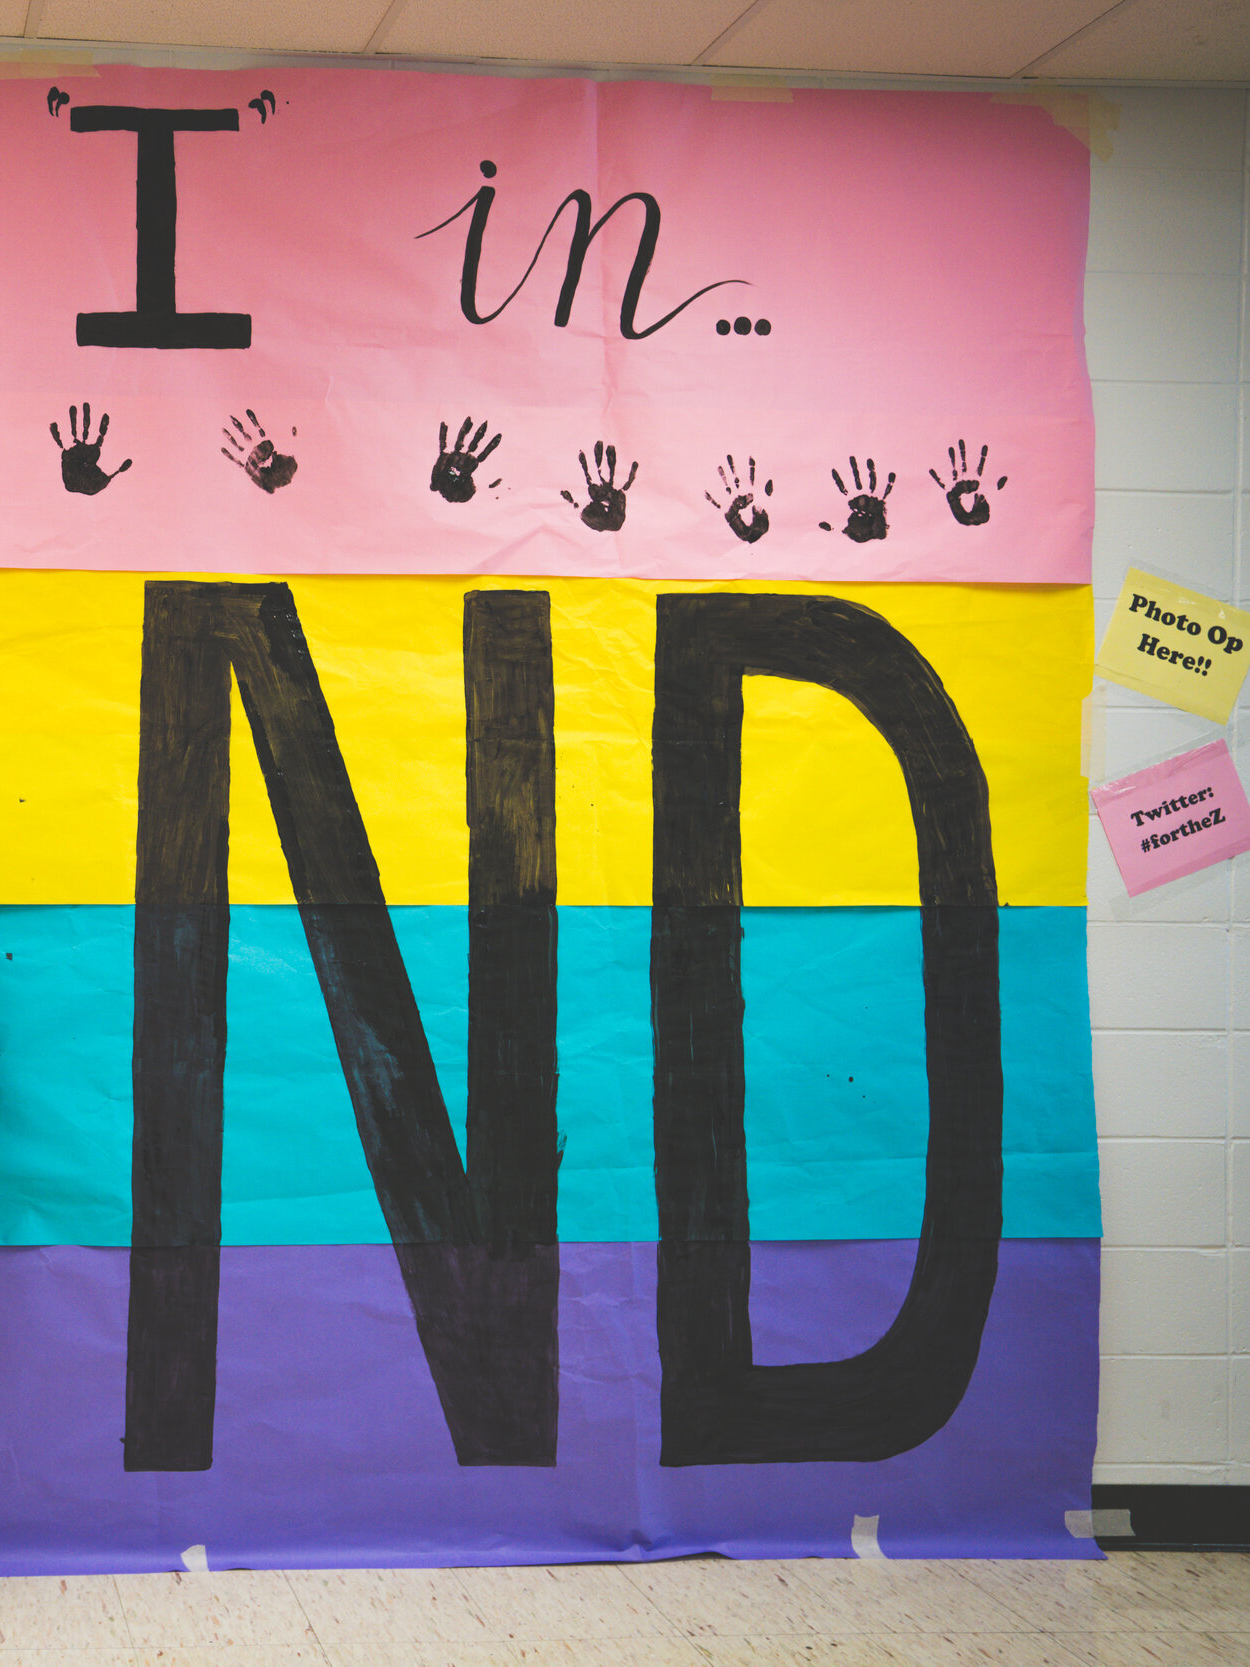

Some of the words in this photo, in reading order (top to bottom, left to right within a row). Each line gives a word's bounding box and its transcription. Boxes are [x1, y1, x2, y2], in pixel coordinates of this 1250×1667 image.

[1129, 594, 1201, 635] Photo
[1208, 626, 1243, 653] Op
[1137, 634, 1212, 676] Here!!
[1131, 787, 1213, 826] Twitter:
[1141, 808, 1225, 853] #fortheZ
